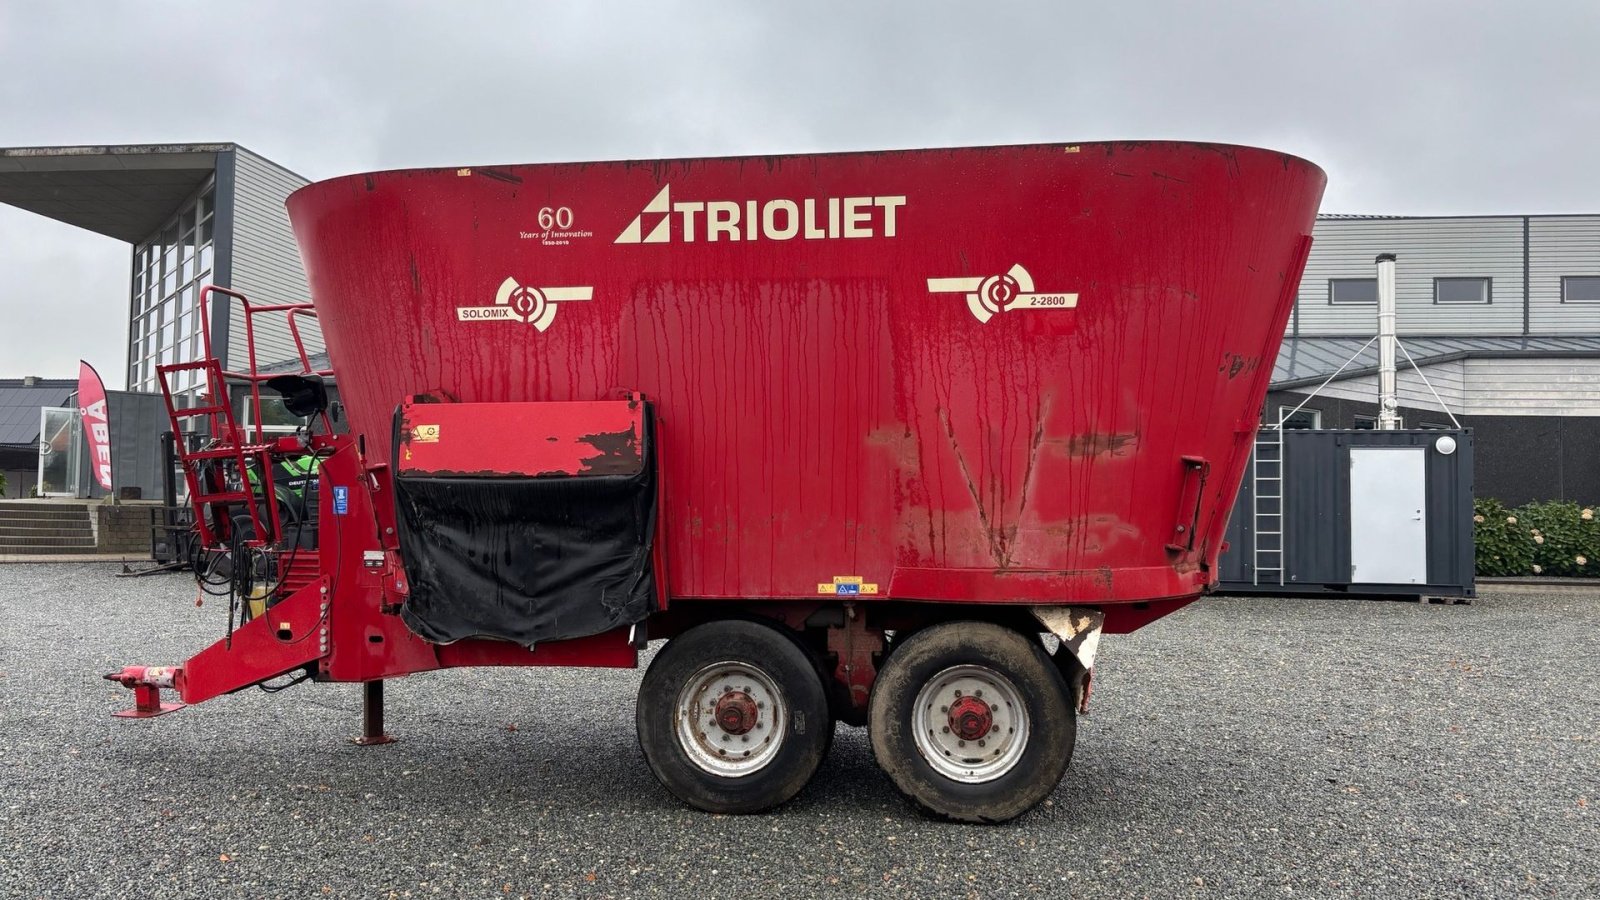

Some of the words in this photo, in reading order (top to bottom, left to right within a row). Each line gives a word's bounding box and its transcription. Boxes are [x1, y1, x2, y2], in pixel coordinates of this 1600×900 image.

[537, 206, 574, 230] 60
[673, 195, 907, 243] TRIOLIET
[519, 231, 539, 239] Years
[541, 230, 550, 240] of
[551, 230, 593, 238] Innovation
[1030, 296, 1065, 306] 2-2800
[462, 308, 509, 319] SOLOMIX
[80, 399, 112, 487] ÅBEN
